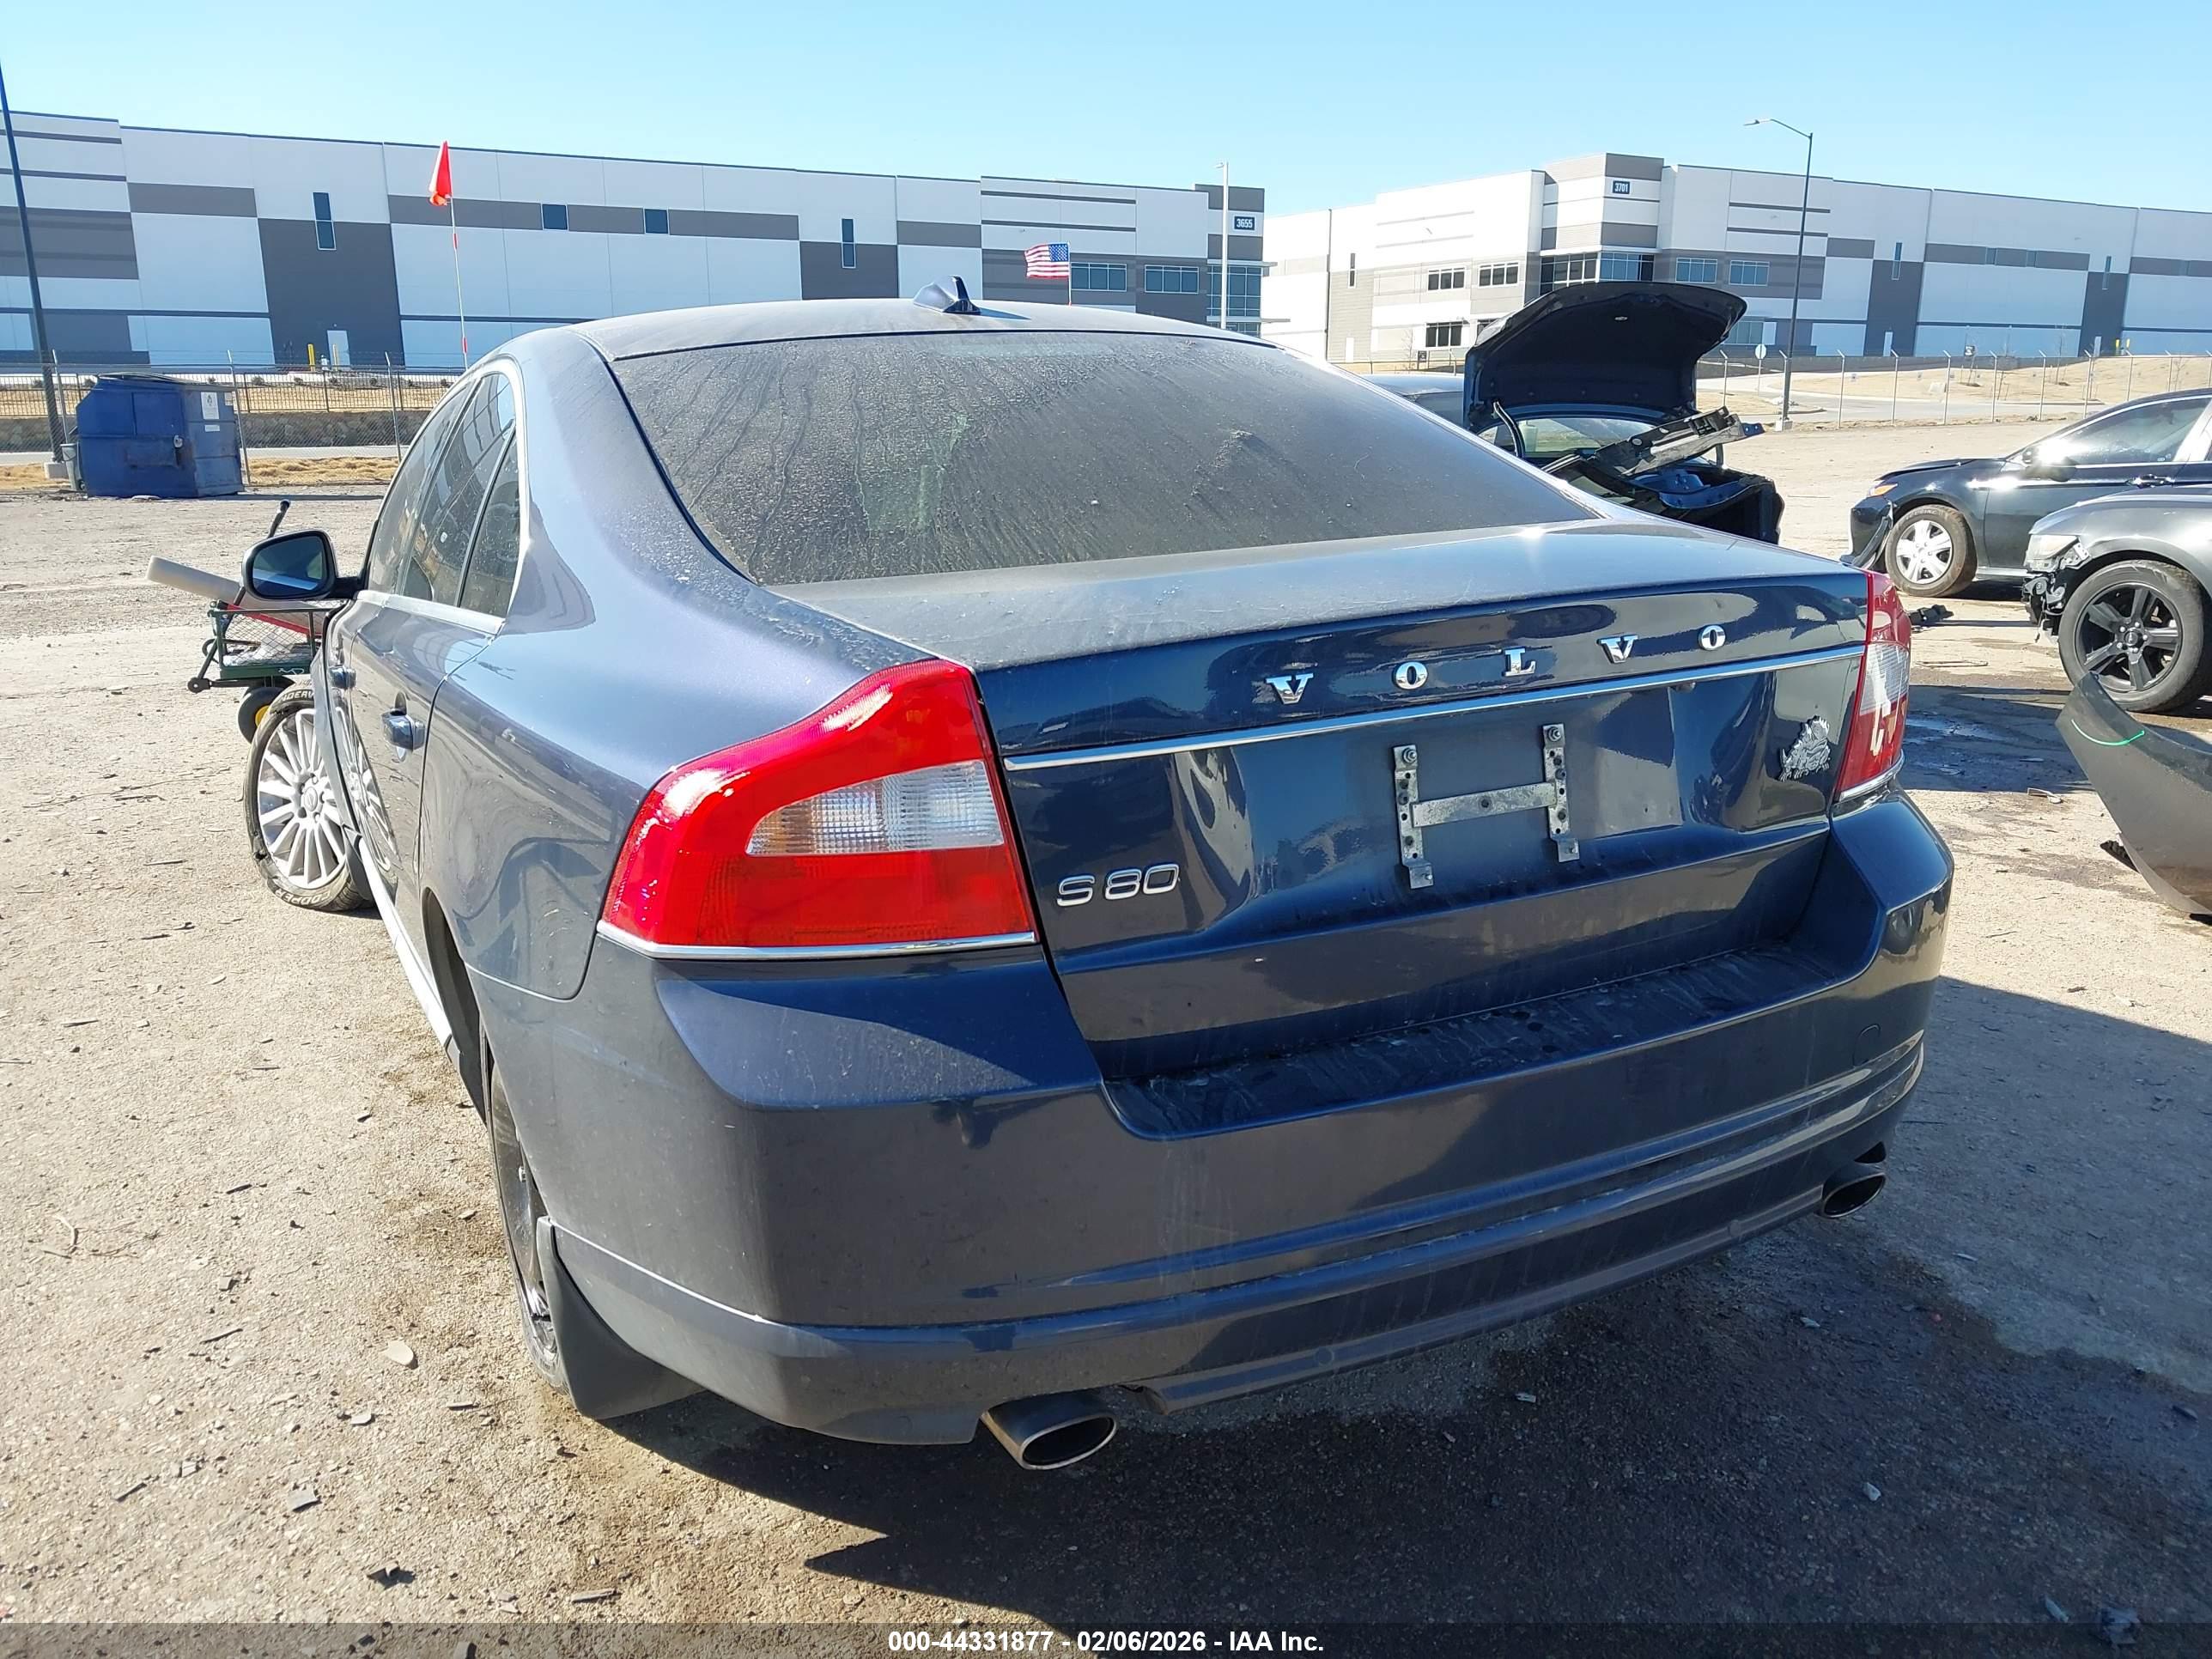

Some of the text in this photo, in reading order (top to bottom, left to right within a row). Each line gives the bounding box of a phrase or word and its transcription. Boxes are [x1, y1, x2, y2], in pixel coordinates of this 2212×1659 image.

[1613, 182, 1629, 193] 3701
[1236, 218, 1253, 228] 3655
[1265, 623, 1727, 706] VOLVO
[274, 888, 331, 906] COOPER
